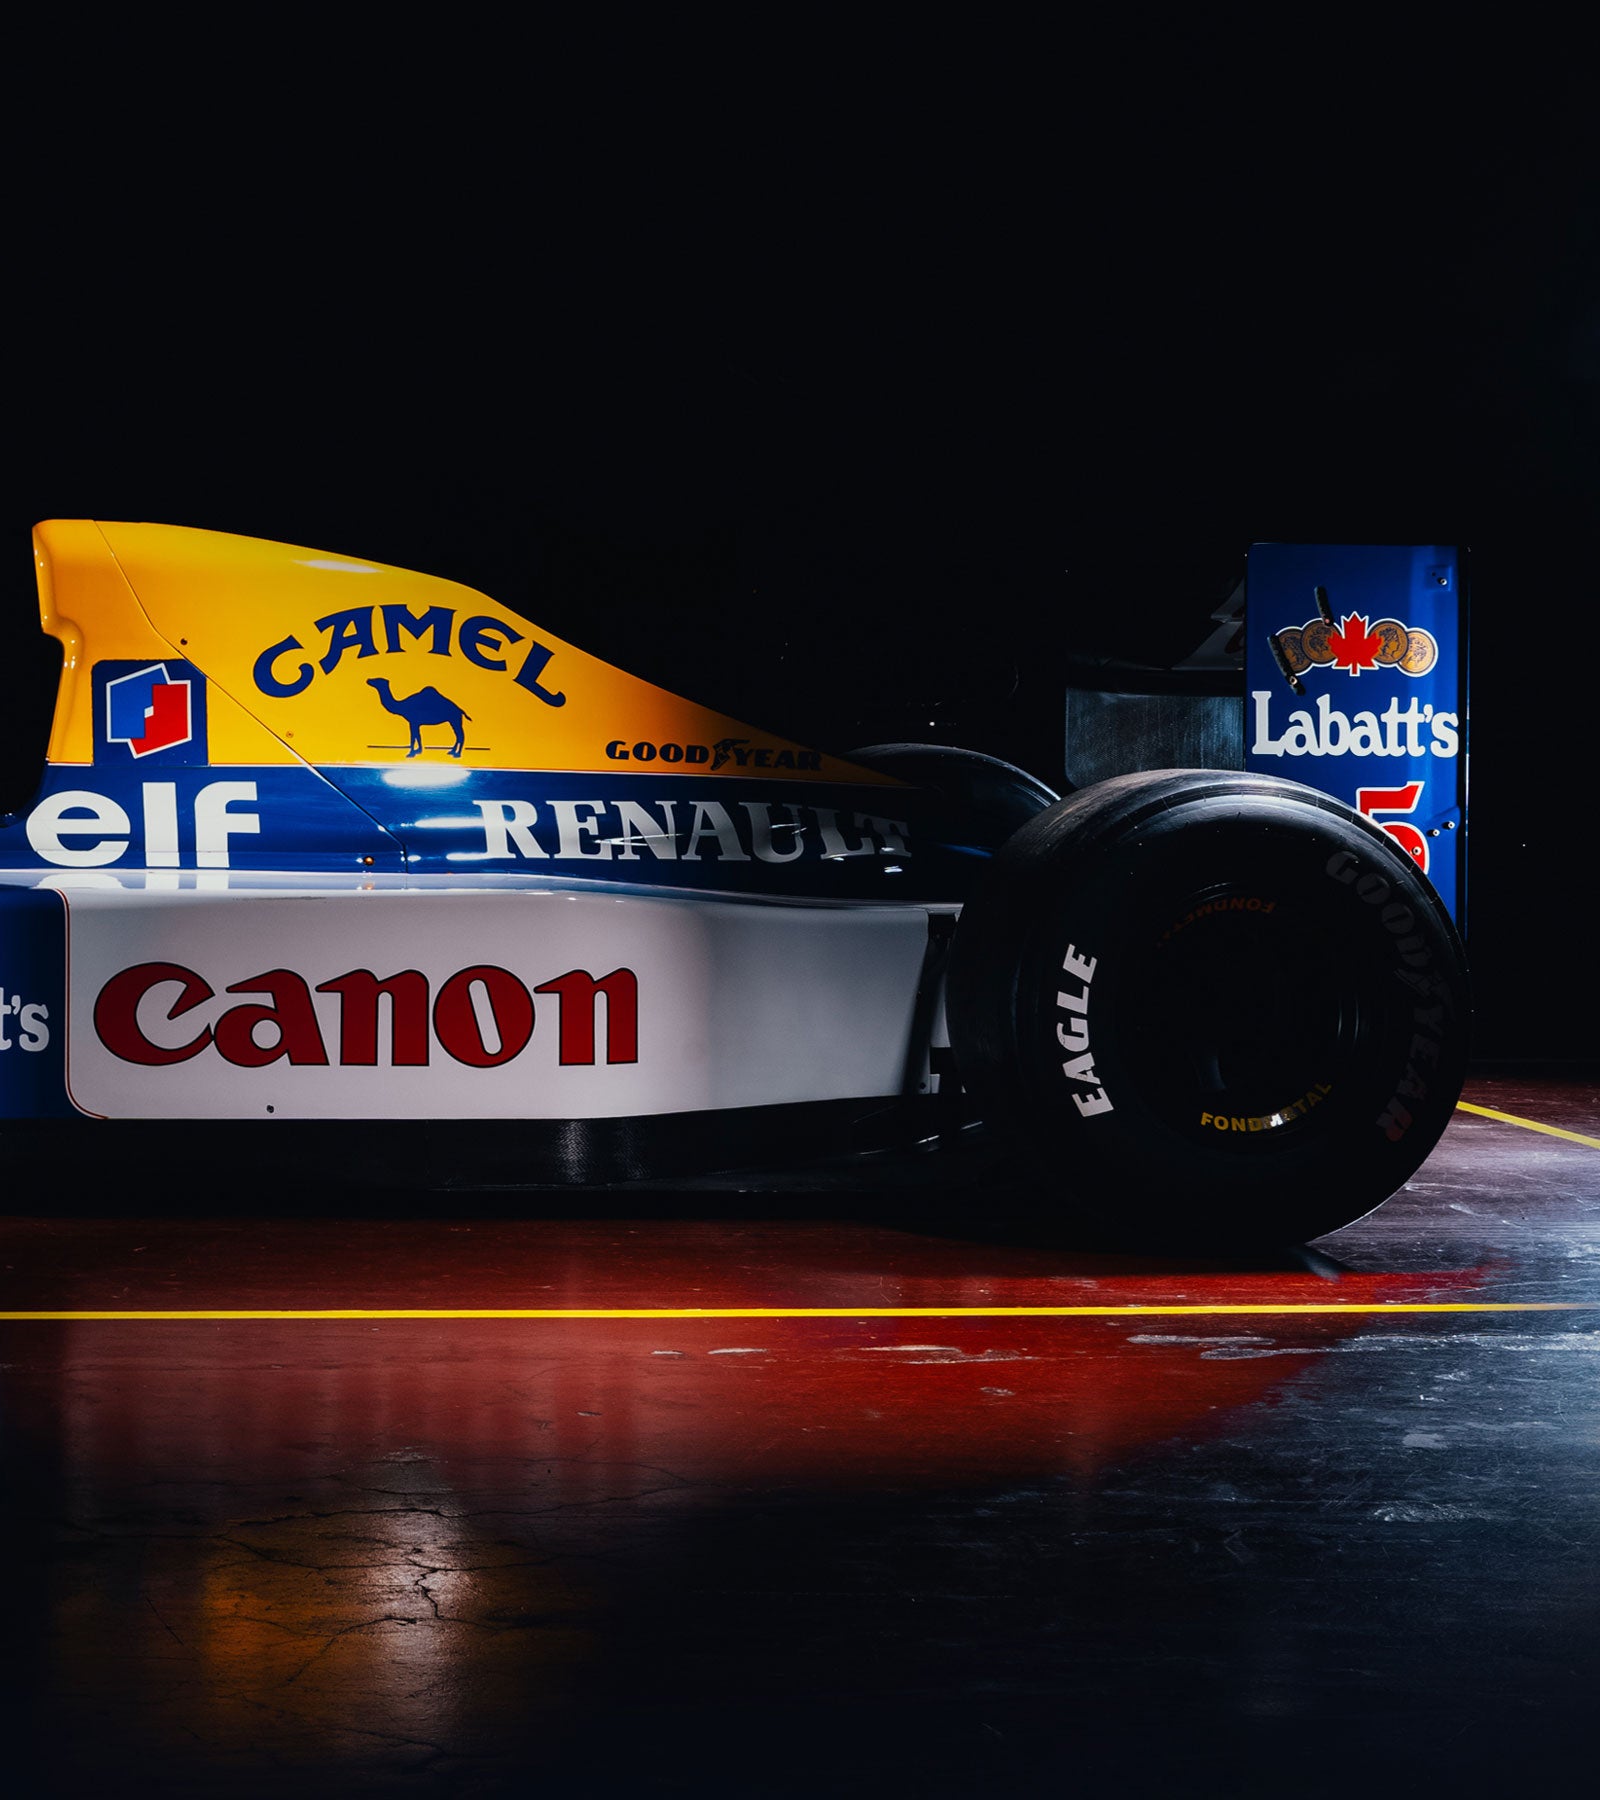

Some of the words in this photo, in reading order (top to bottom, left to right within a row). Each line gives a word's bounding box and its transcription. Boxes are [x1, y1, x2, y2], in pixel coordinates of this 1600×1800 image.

[252, 603, 567, 708] CAMEL
[1250, 690, 1460, 760] Labatt's
[25, 780, 261, 869] elf
[471, 799, 914, 864] RENAULT
[1356, 780, 1431, 877] 5
[1154, 895, 1279, 951] FONDME
[93, 960, 640, 1068] Canon
[1055, 942, 1118, 1118] EAGLE
